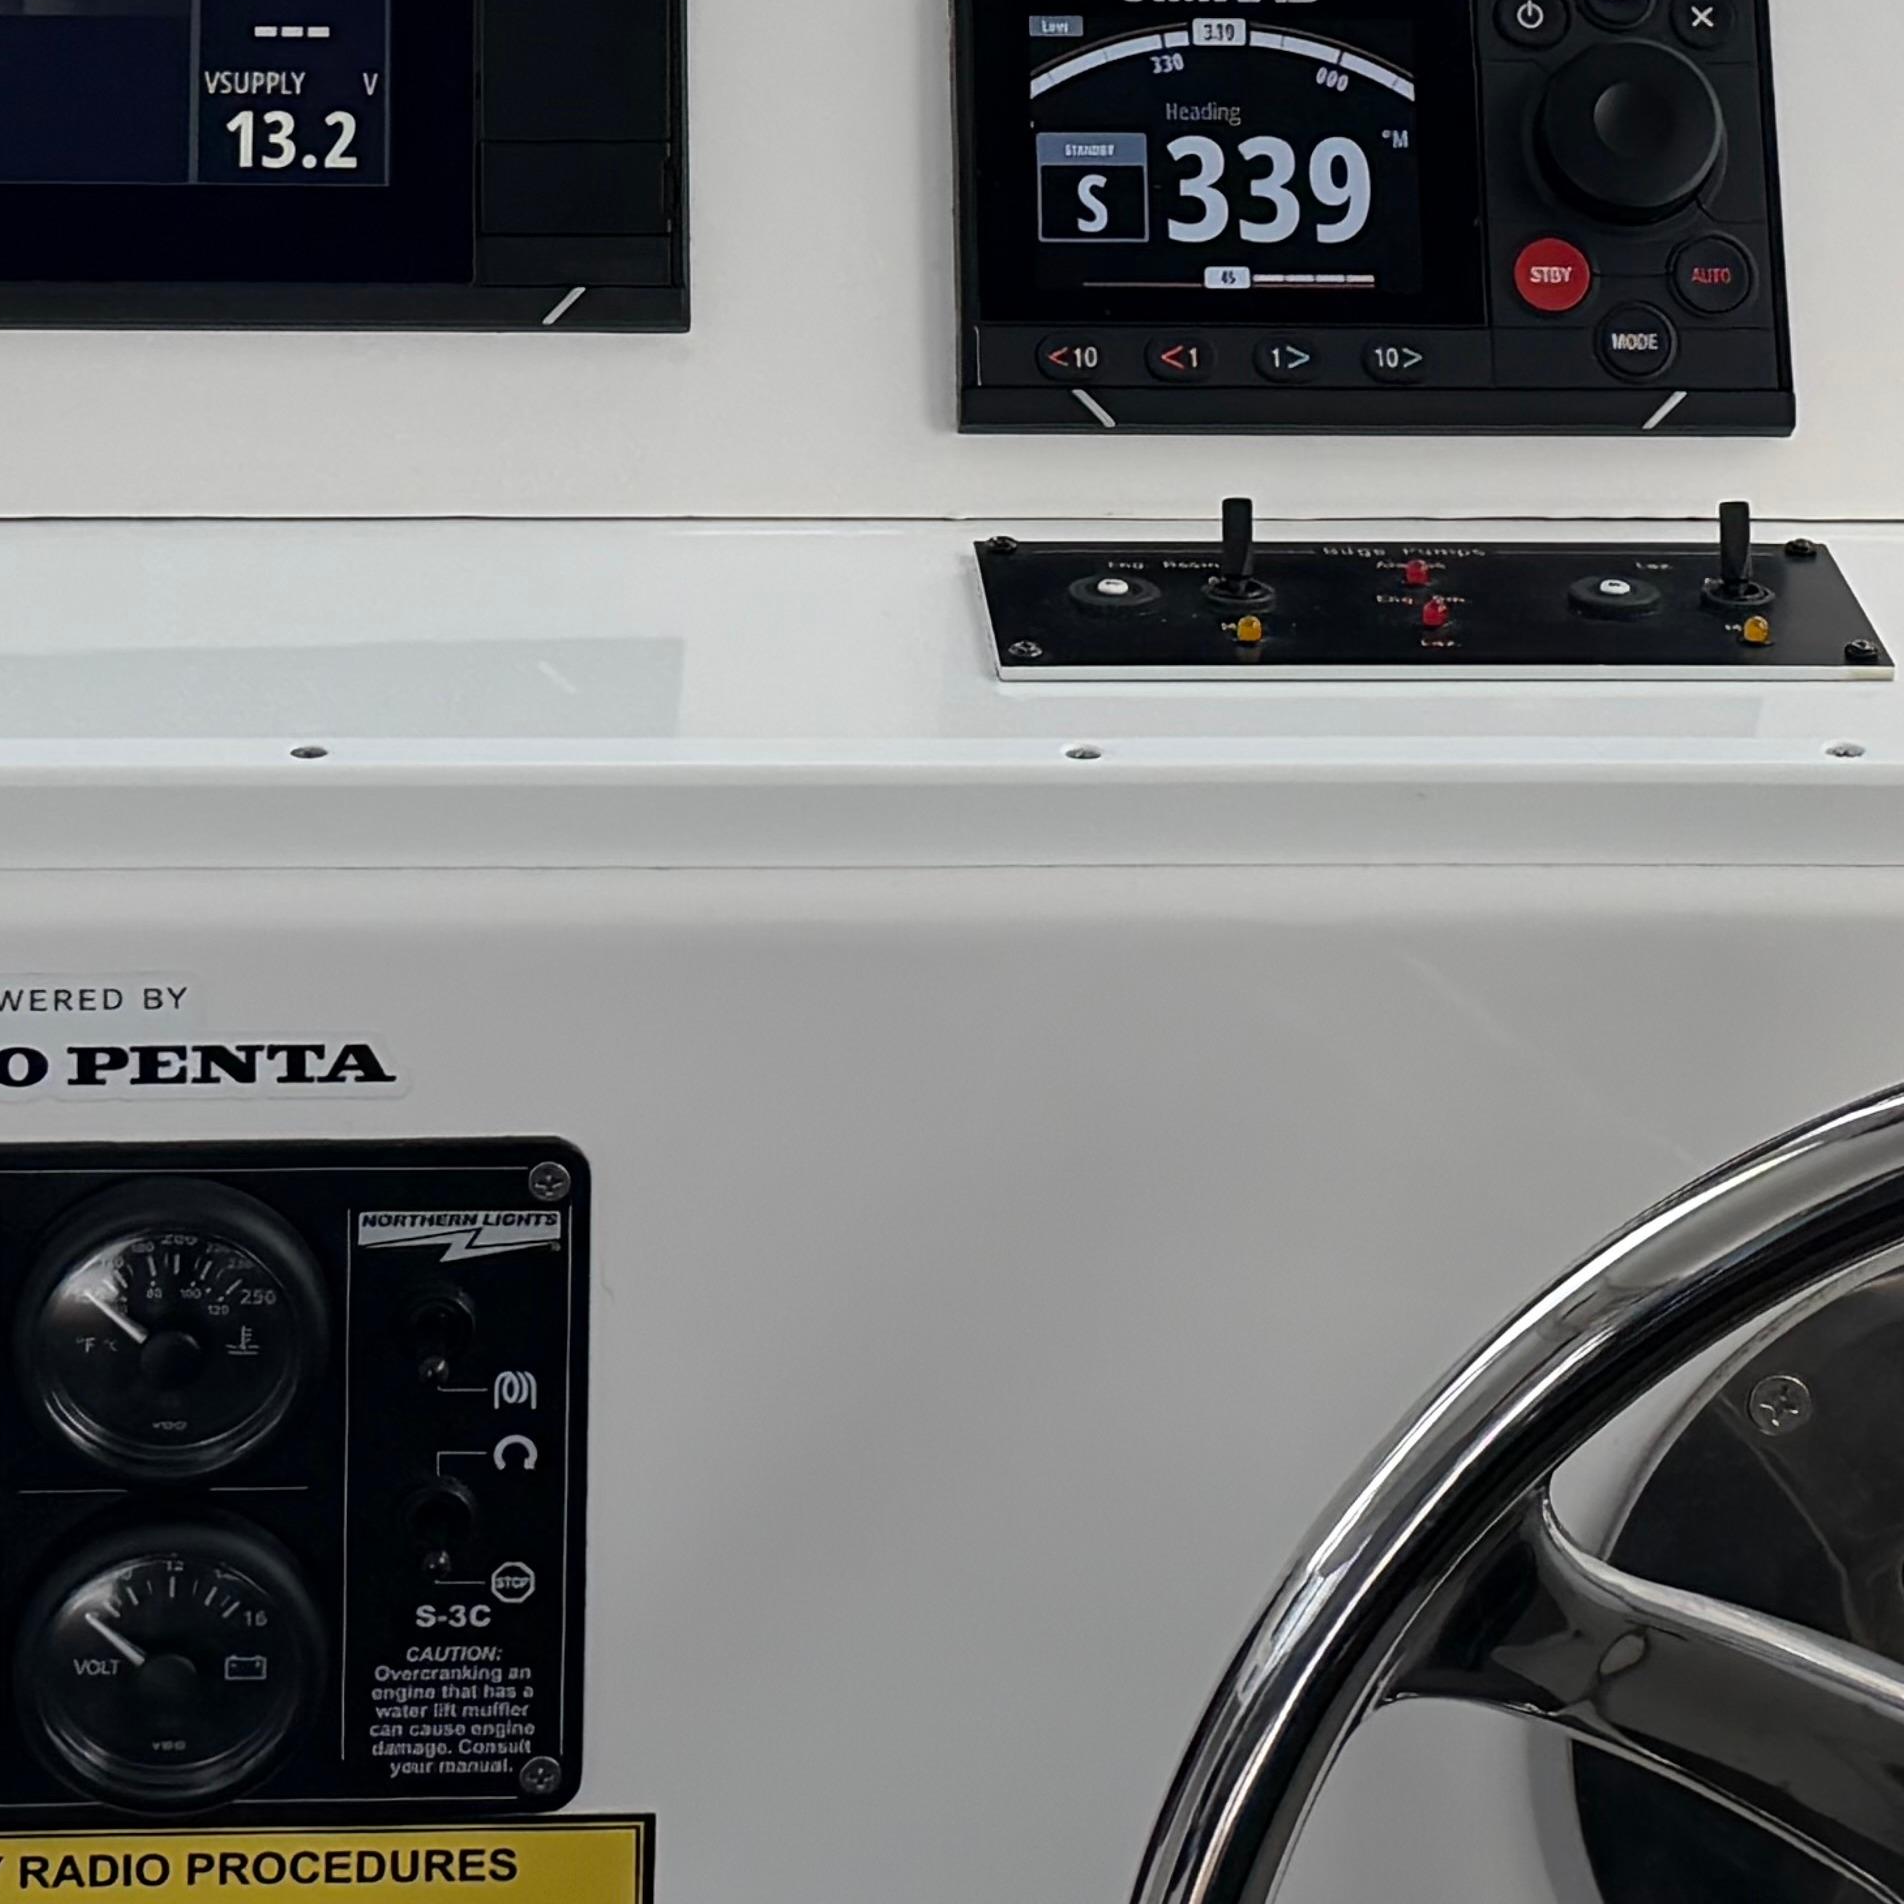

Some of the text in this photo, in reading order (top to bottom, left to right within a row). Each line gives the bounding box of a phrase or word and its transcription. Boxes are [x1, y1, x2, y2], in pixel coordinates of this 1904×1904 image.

[1150, 53, 1185, 75] 330
[205, 70, 379, 96] VSUPPLY V
[1165, 102, 1242, 128] Heading
[226, 109, 358, 170] 13.2
[1076, 134, 1372, 245] S 339
[1529, 266, 1573, 285] STBY
[1690, 266, 1732, 284] AUTO
[1610, 332, 1659, 352] MODE
[143, 986, 188, 1012] BY
[66, 1043, 397, 1087] PENTA
[361, 1213, 558, 1228] NORTHERN LIGHTS
[240, 1289, 277, 1306] 250
[242, 1610, 269, 1627] 16
[415, 1603, 492, 1628] S-3C
[405, 1646, 504, 1663] CAUTION:
[72, 1658, 122, 1676] VOLT
[374, 1664, 532, 1684] Overcranking an
[371, 1683, 535, 1703] engine that has a
[375, 1702, 530, 1719] water lift muffler
[369, 1719, 536, 1739] can cause engine
[371, 1738, 532, 1759] damage. Consult
[390, 1758, 514, 1779] your manual.
[17, 1852, 172, 1890] RADIO
[185, 1846, 519, 1886] PROCEDURES
